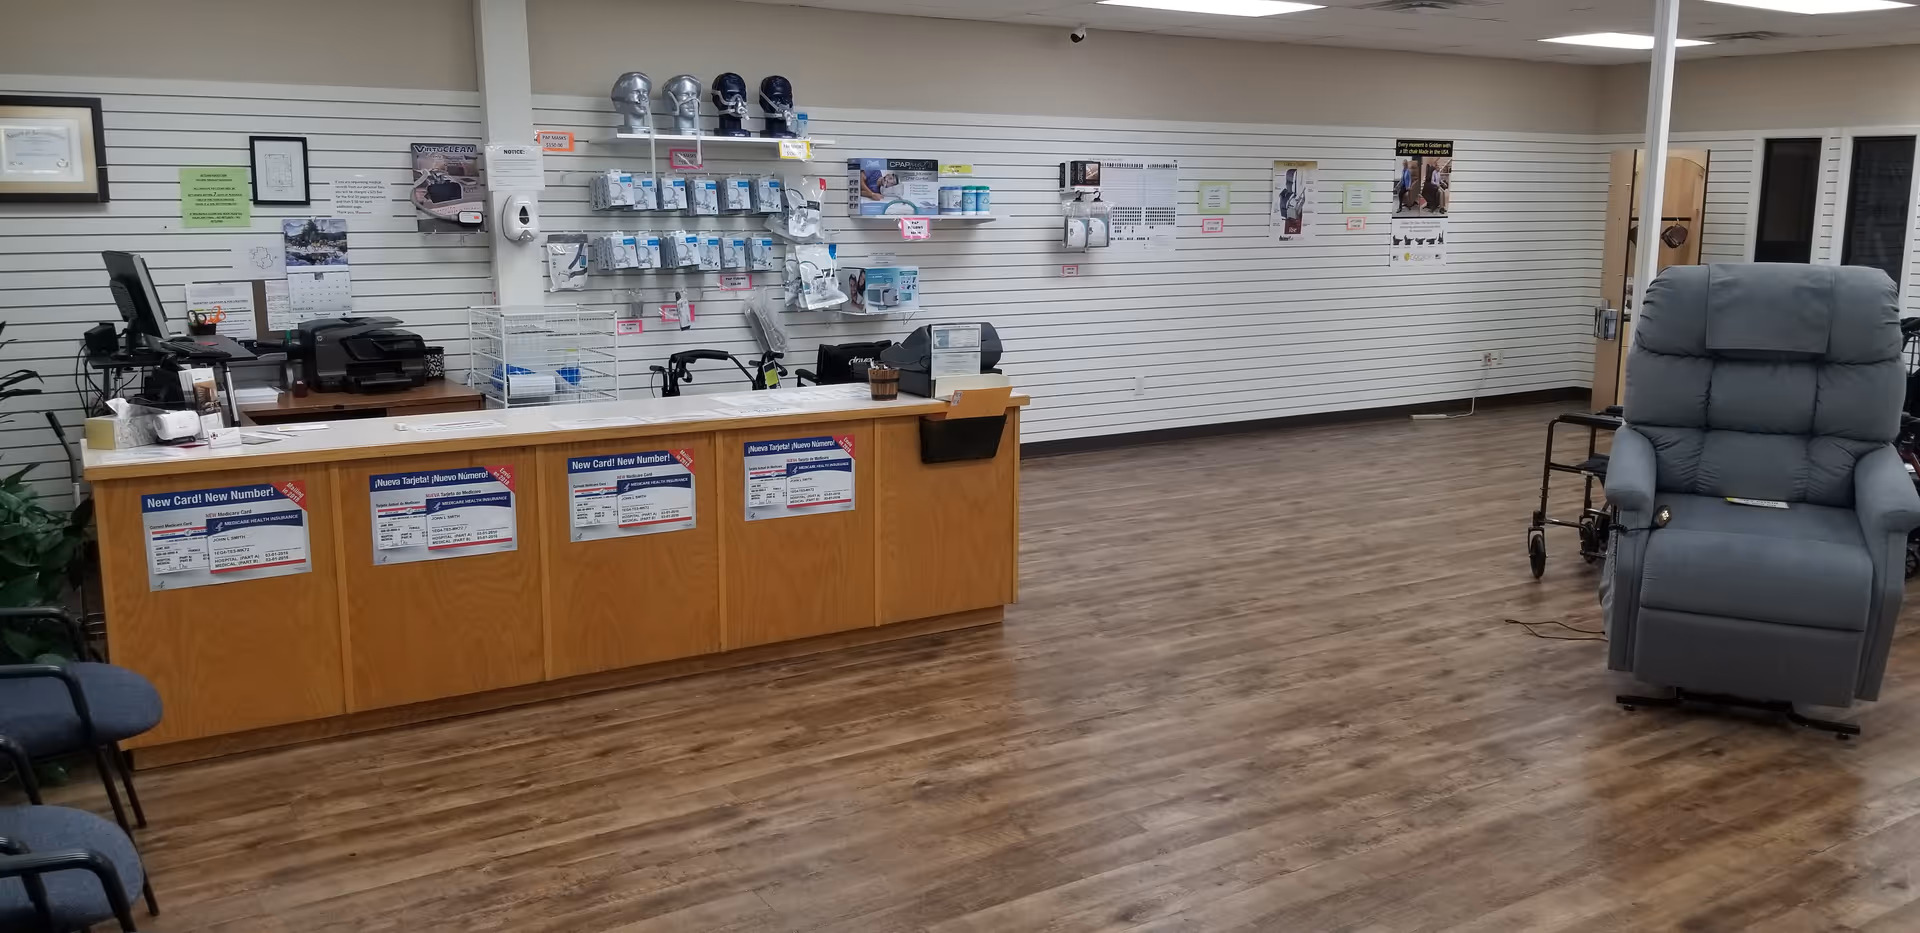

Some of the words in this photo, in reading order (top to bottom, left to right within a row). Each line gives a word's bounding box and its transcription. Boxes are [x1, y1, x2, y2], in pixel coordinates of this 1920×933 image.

[748, 445, 768, 454] ¡Nueva
[769, 443, 790, 452] Tarjeta!
[791, 442, 810, 451] ¡Nuevo
[812, 440, 835, 448] Número!
[572, 461, 591, 470] New
[593, 459, 615, 467] Card!
[617, 457, 635, 466] New
[636, 453, 670, 465] Number!
[374, 478, 400, 489] ¡Nueva
[402, 475, 430, 486] Tarjeta!
[431, 473, 456, 484] ¡Nuevo
[458, 470, 488, 481] Número!
[147, 497, 172, 508] New
[173, 494, 202, 506] Card!
[205, 492, 229, 503] New
[230, 487, 274, 500] Number!
[286, 482, 304, 498] Mailing
[286, 491, 300, 503] 2018
